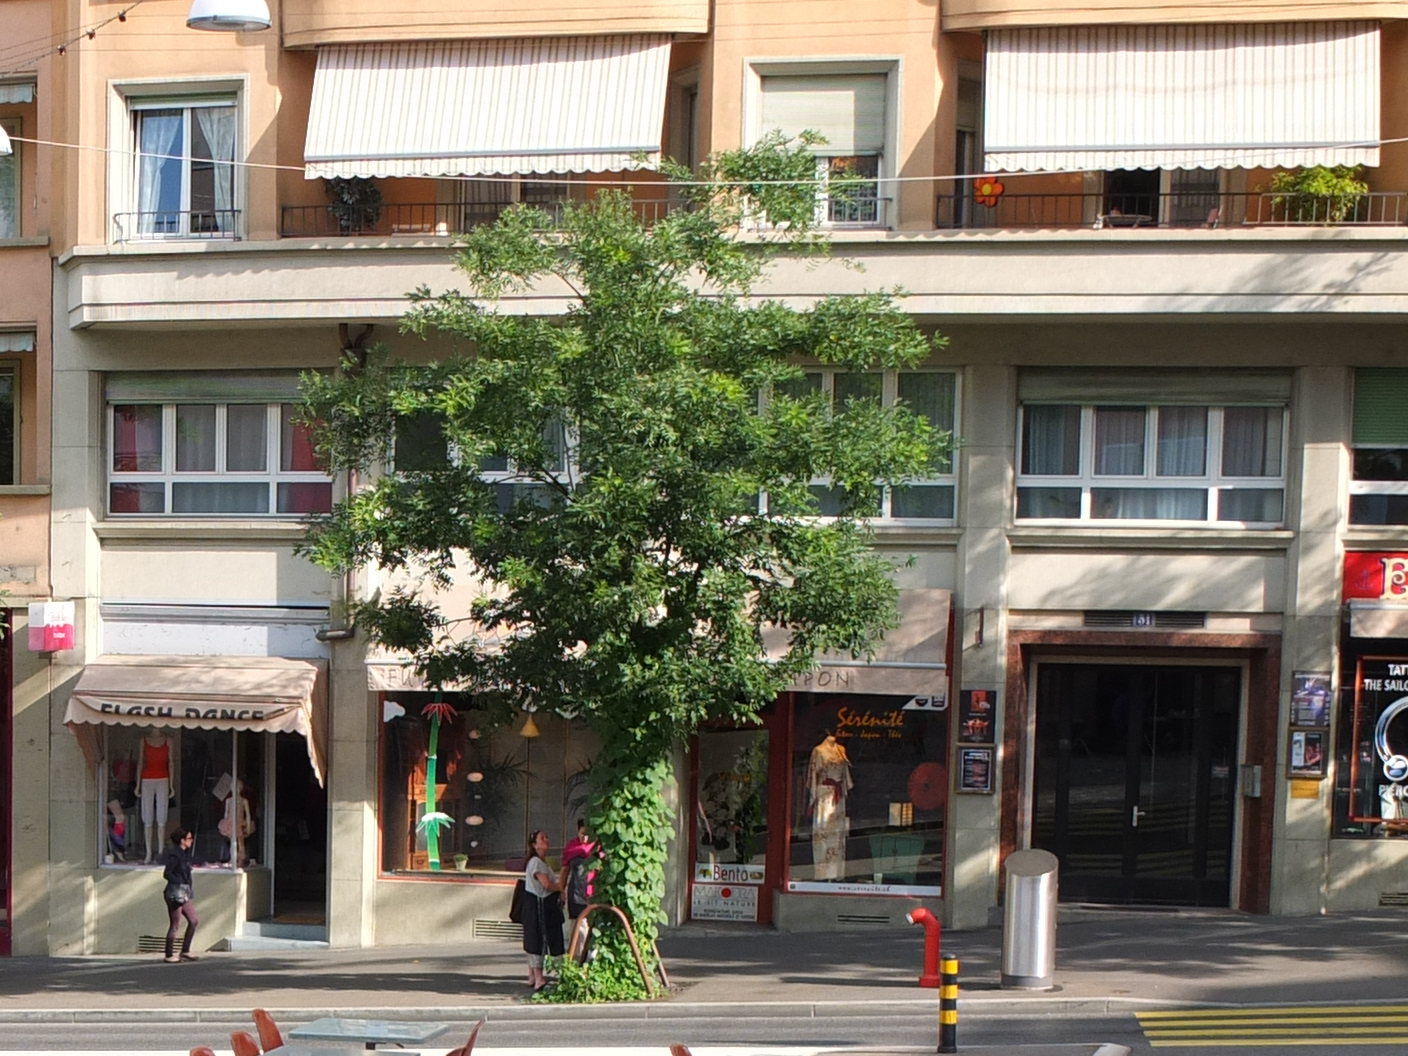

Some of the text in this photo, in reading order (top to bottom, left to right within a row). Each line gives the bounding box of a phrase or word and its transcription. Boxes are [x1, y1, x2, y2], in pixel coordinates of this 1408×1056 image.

[1363, 679, 1382, 691] THE
[836, 706, 906, 727] Sérénité
[713, 865, 748, 881] Bento
